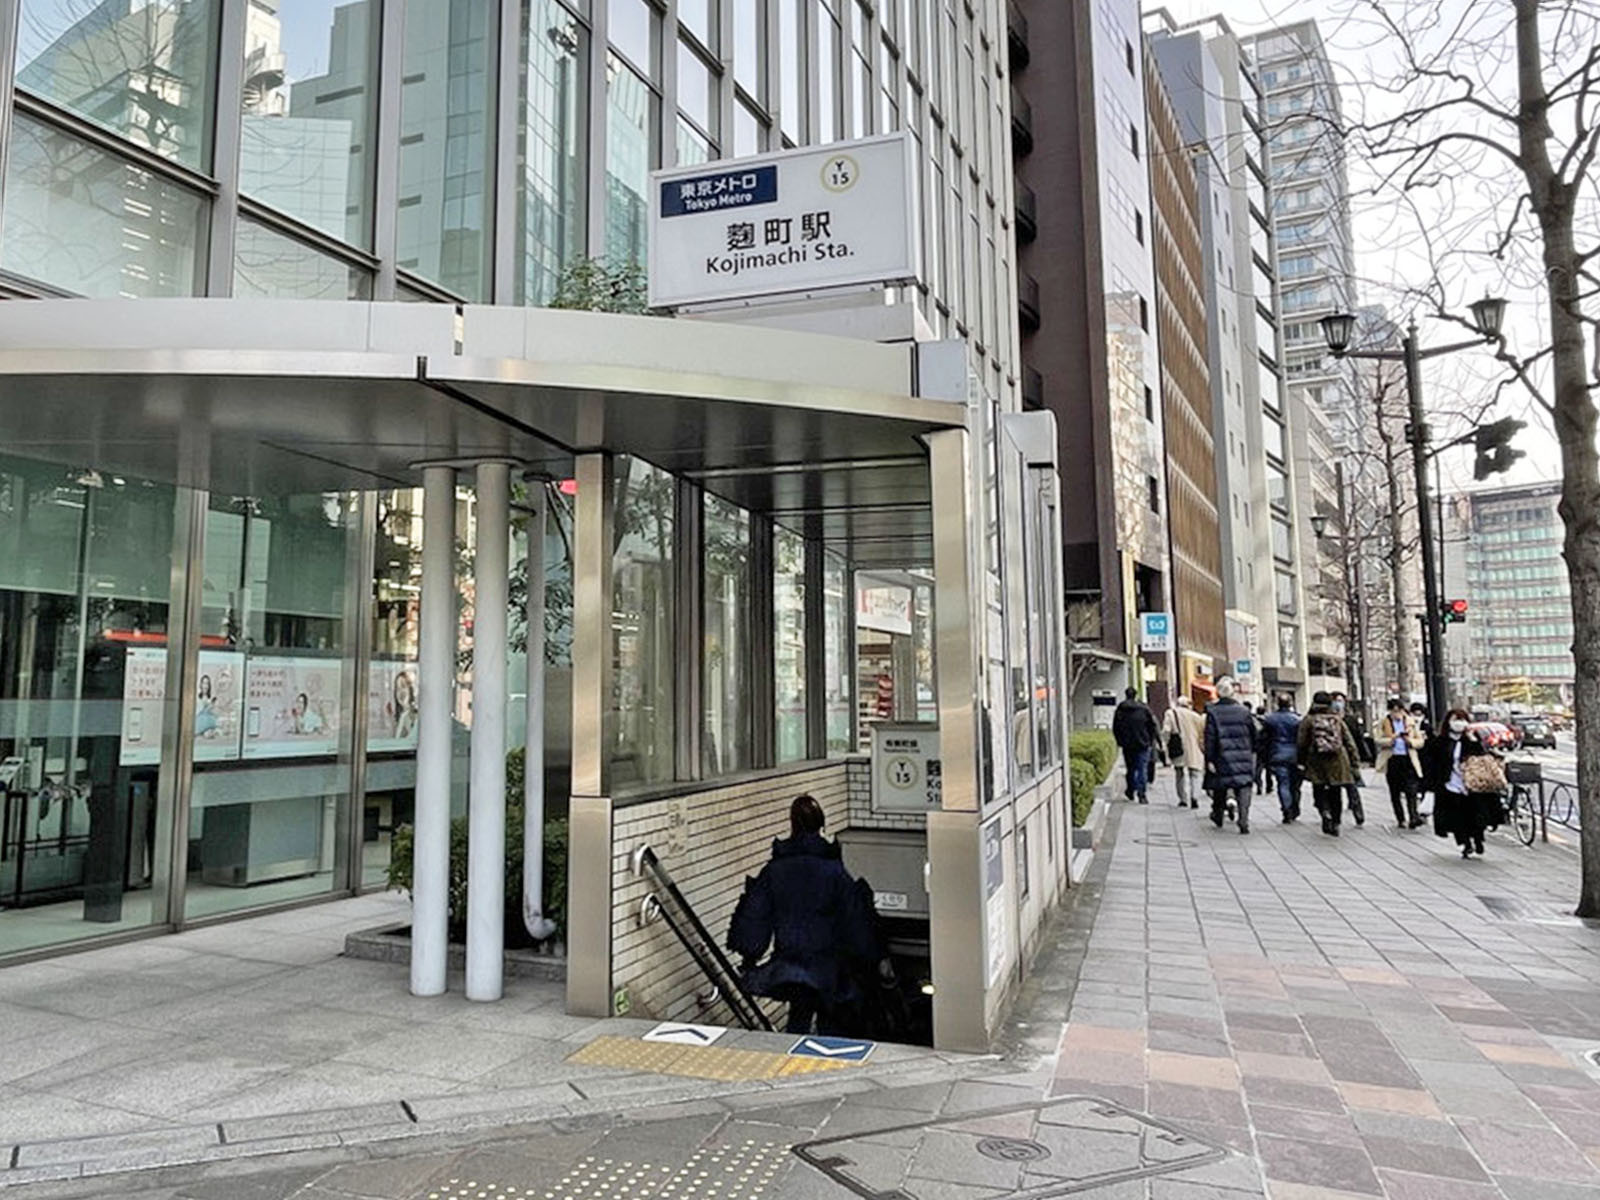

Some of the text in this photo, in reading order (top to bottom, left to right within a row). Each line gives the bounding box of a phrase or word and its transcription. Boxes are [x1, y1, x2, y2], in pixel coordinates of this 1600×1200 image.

[835, 160, 845, 172] Y
[832, 172, 849, 185] 15
[681, 174, 756, 199] 東京メトロ
[685, 193, 753, 210] Tokyo Metro
[706, 242, 854, 275] Kojimachi Sta.
[898, 761, 906, 771] Y
[896, 772, 911, 784] 15
